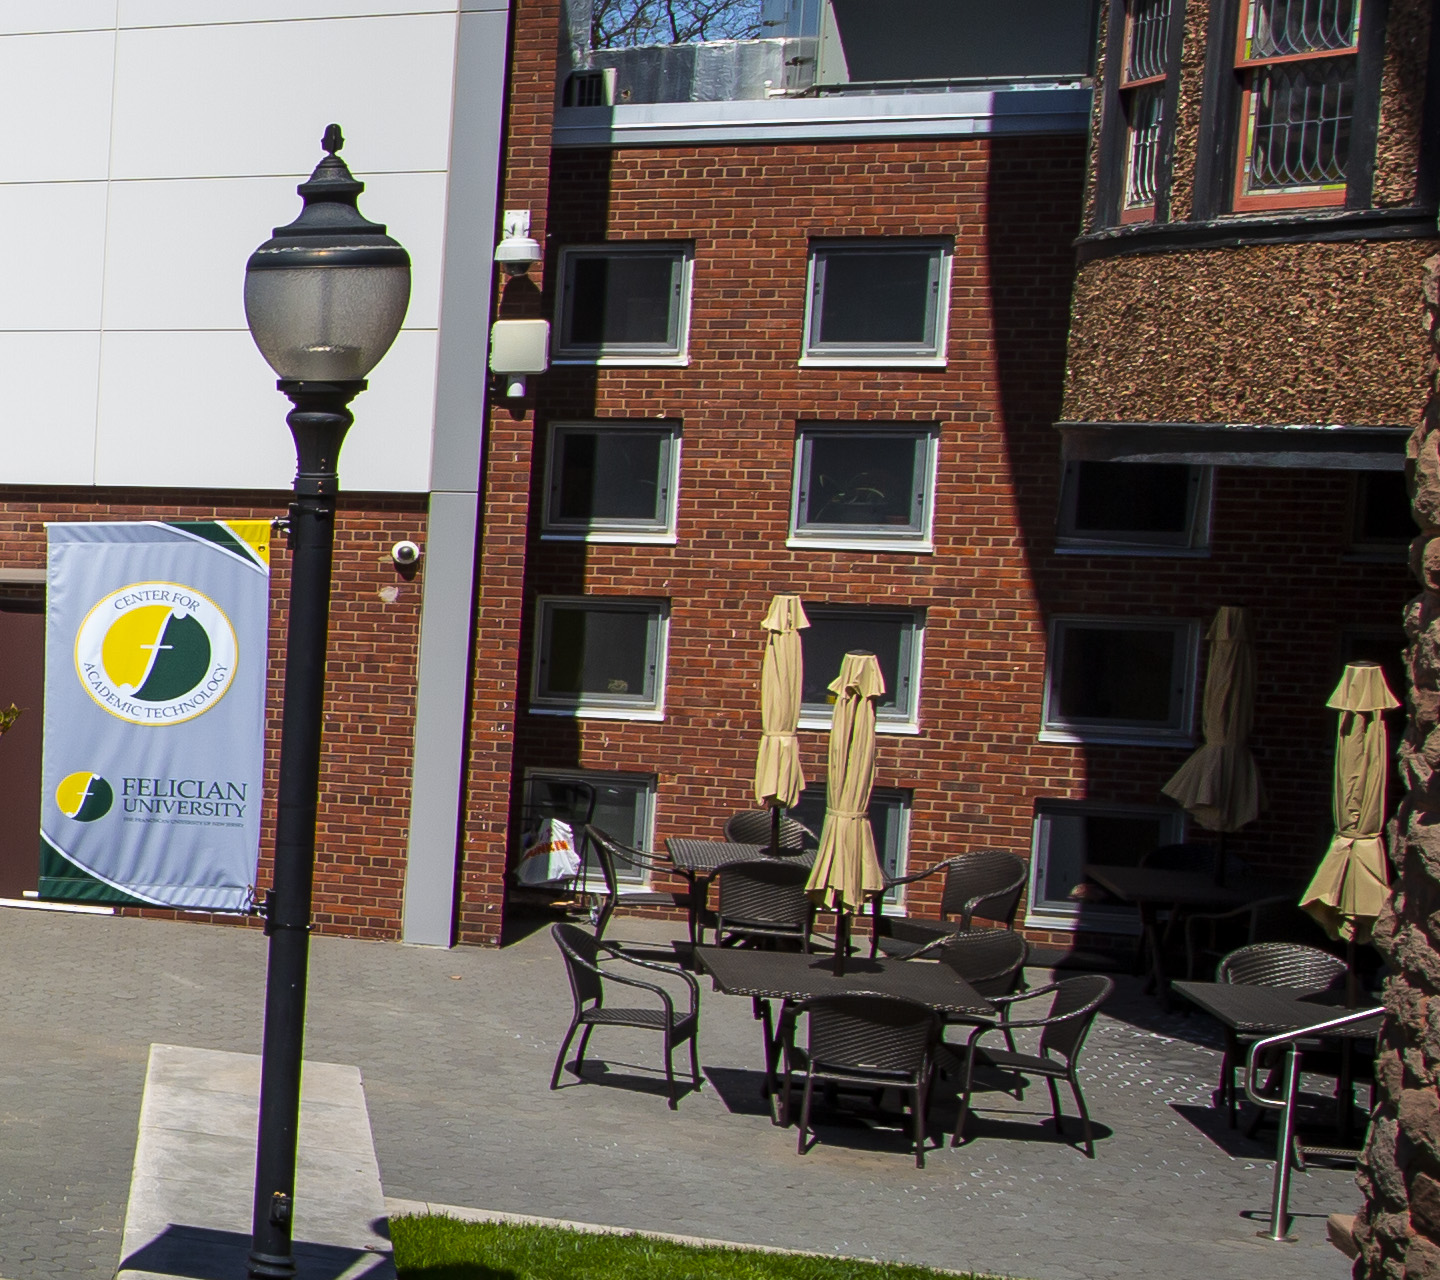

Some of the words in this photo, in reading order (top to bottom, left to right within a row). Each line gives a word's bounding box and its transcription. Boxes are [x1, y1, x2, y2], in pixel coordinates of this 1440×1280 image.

[114, 590, 169, 610] CENTER
[172, 592, 200, 612] FOR
[83, 662, 143, 716] ACADEMIC
[144, 663, 229, 719] TECHNOLOGY
[121, 777, 248, 802] FELICIAN
[123, 798, 247, 818] UNIVERSITY
